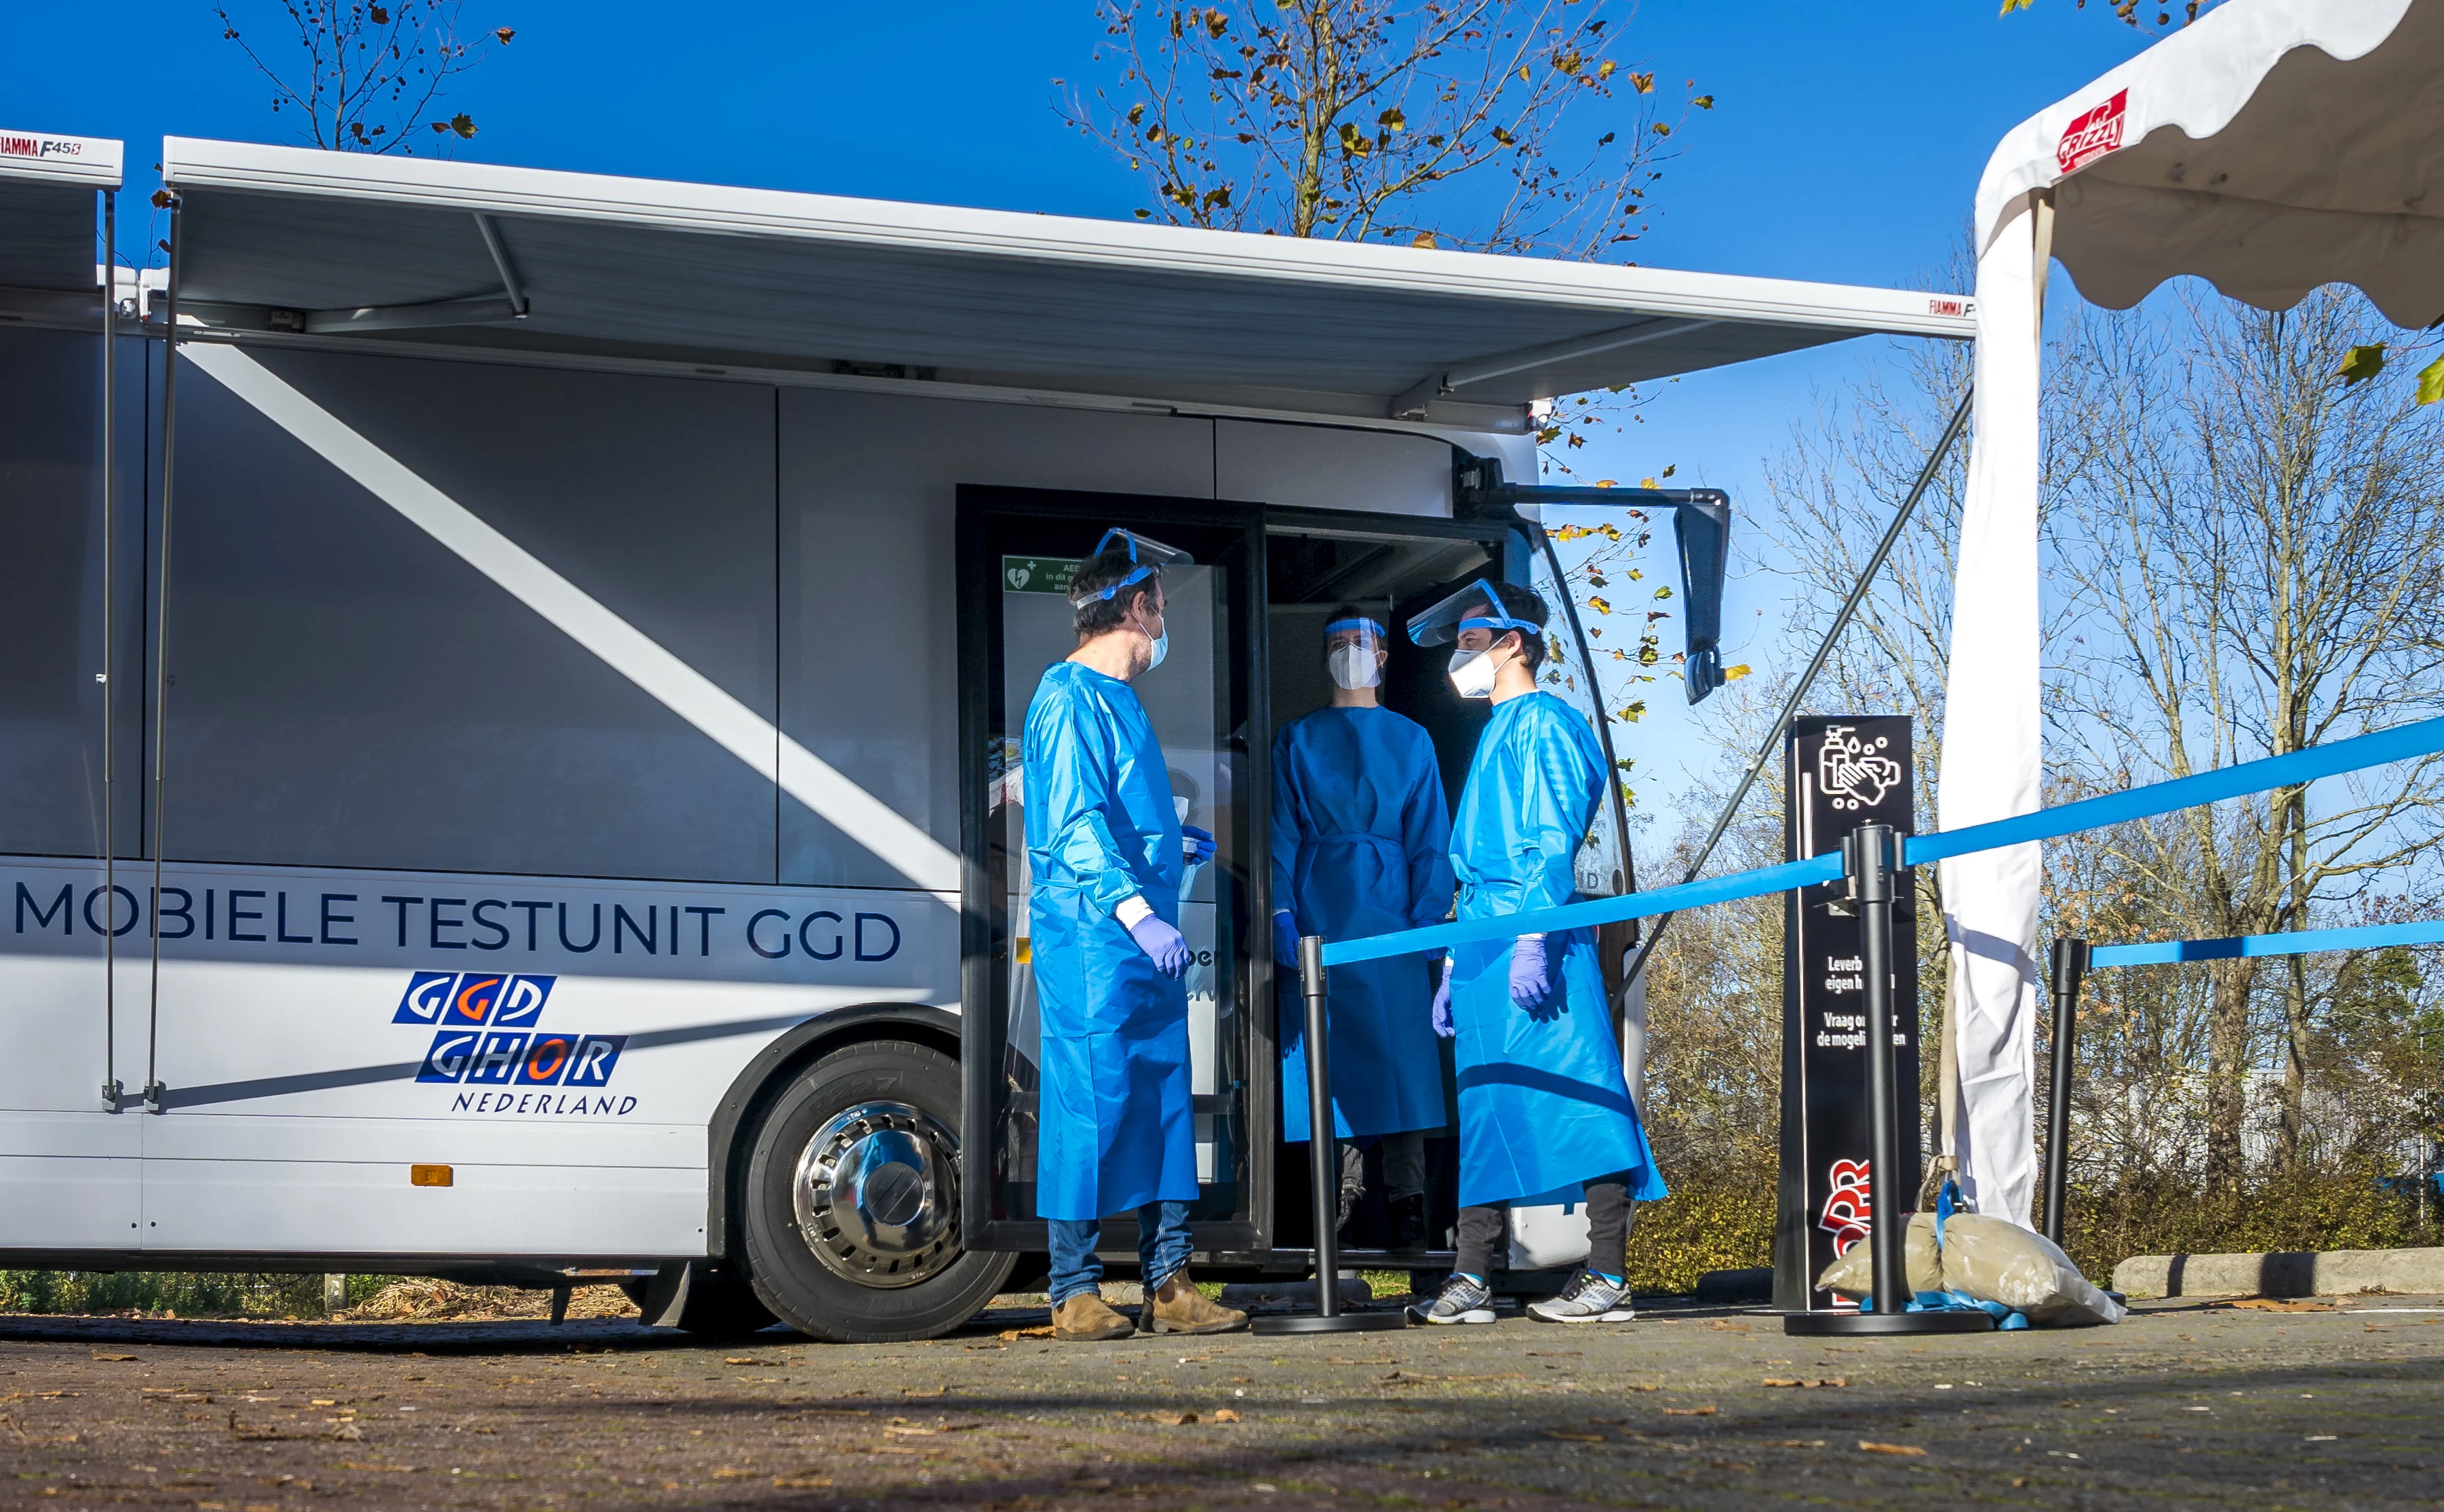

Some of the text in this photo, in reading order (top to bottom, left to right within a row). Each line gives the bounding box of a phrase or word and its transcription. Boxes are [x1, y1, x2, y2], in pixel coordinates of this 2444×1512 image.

[0, 137, 38, 157] IAMMA
[1963, 303, 1975, 317] F
[15, 881, 901, 963] MOBIELE TESTUNIT GGD
[1827, 955, 1863, 971] Leverb
[1826, 974, 1854, 994] eigen
[408, 976, 543, 1021] GGD
[1824, 1012, 1854, 1031] Vraag
[1817, 1031, 1830, 1046] de
[431, 1035, 613, 1080] GHOR
[451, 1092, 638, 1116] NEDERLAND
